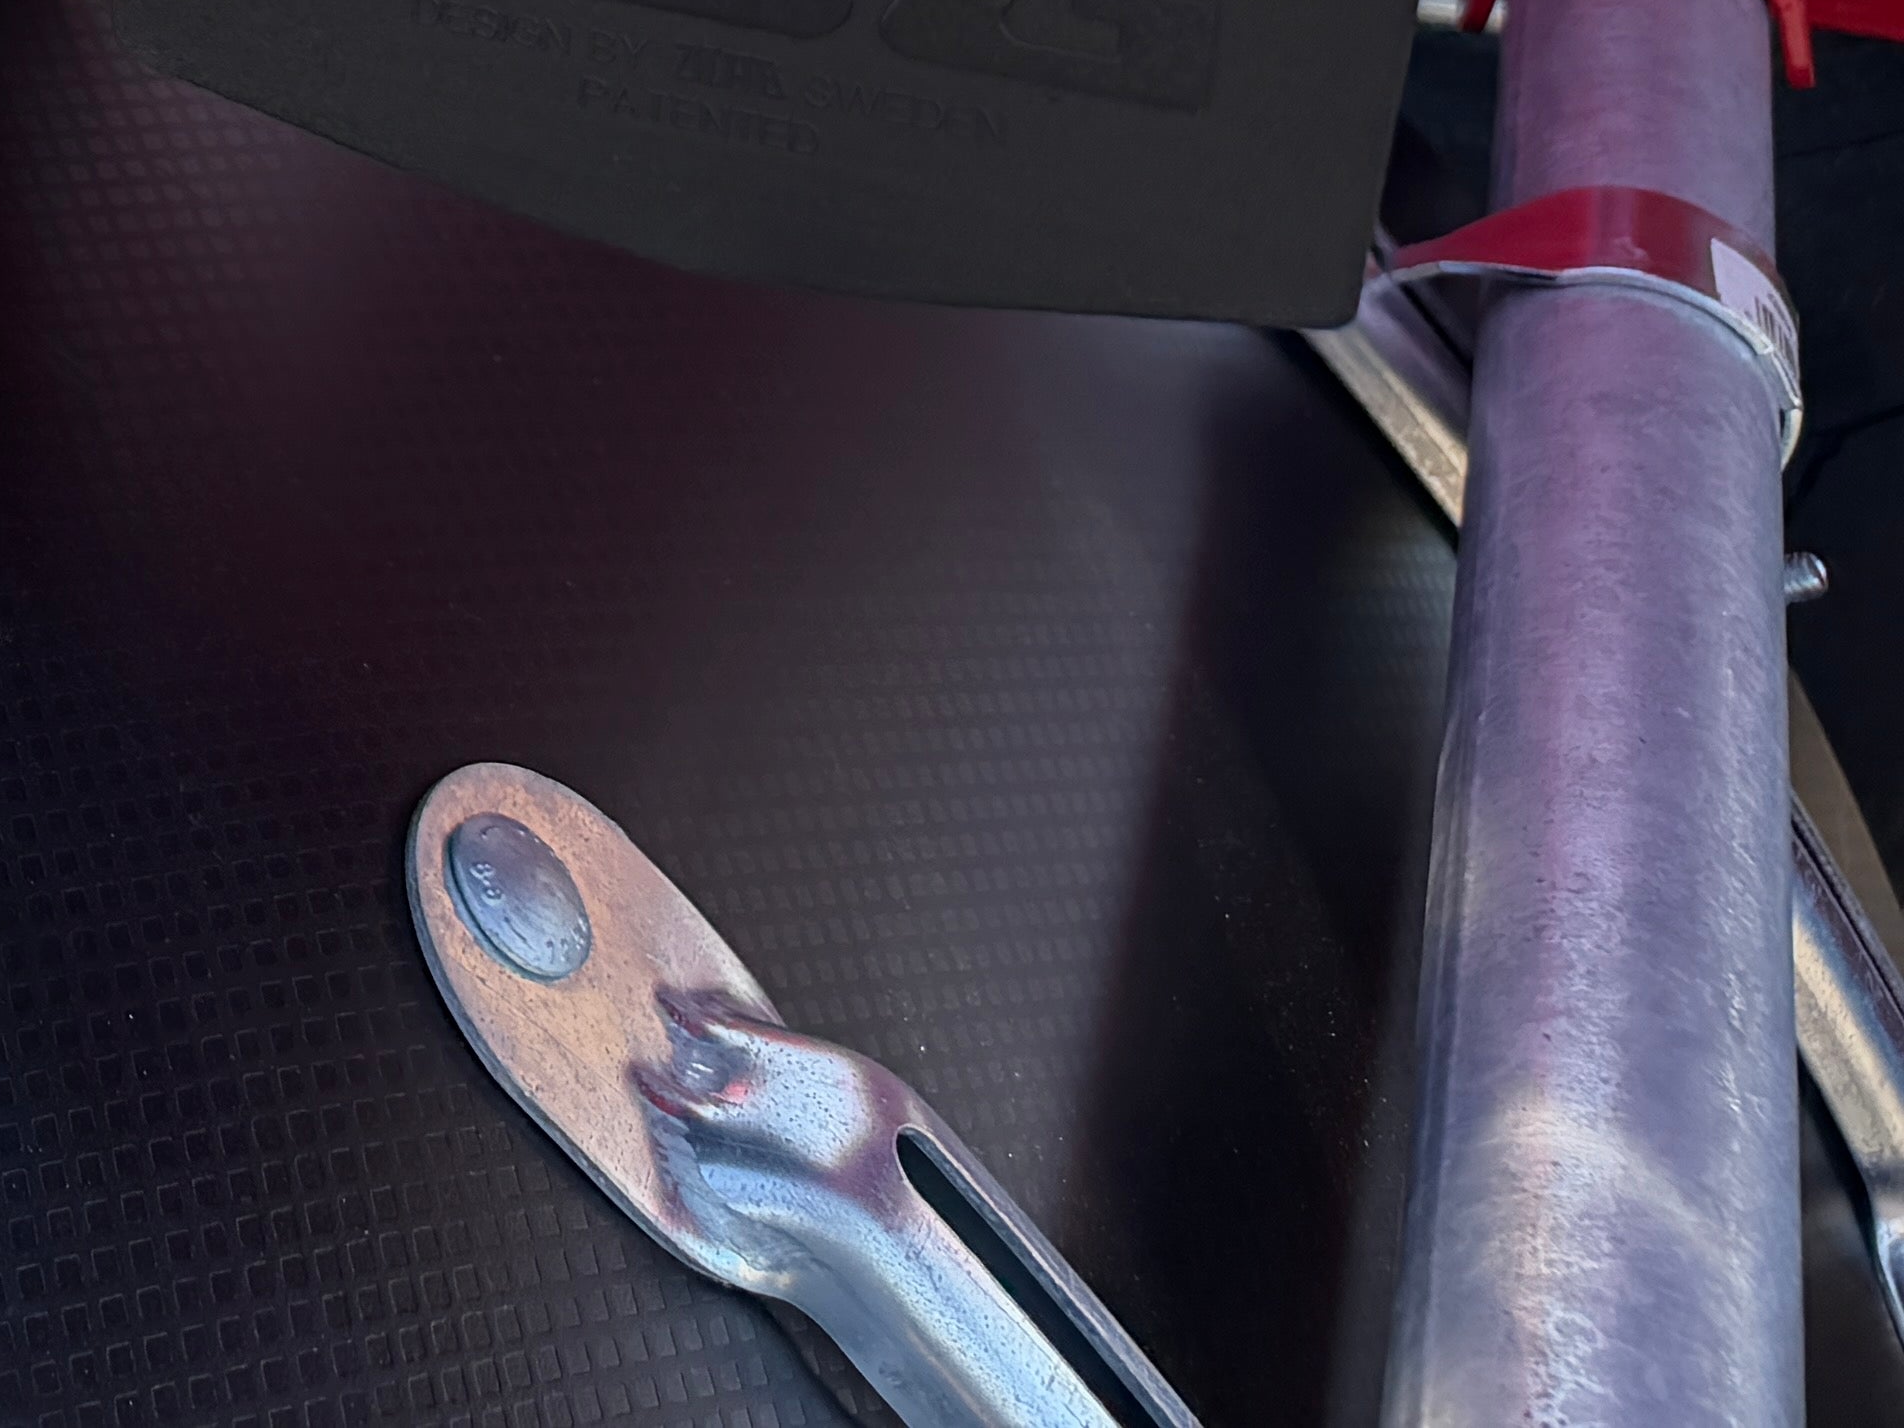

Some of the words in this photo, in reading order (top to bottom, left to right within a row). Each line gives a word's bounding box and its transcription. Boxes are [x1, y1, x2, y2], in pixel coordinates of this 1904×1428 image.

[576, 76, 823, 154] PATENTED
[587, 29, 649, 70] BY
[804, 74, 1009, 143] SWEDEN
